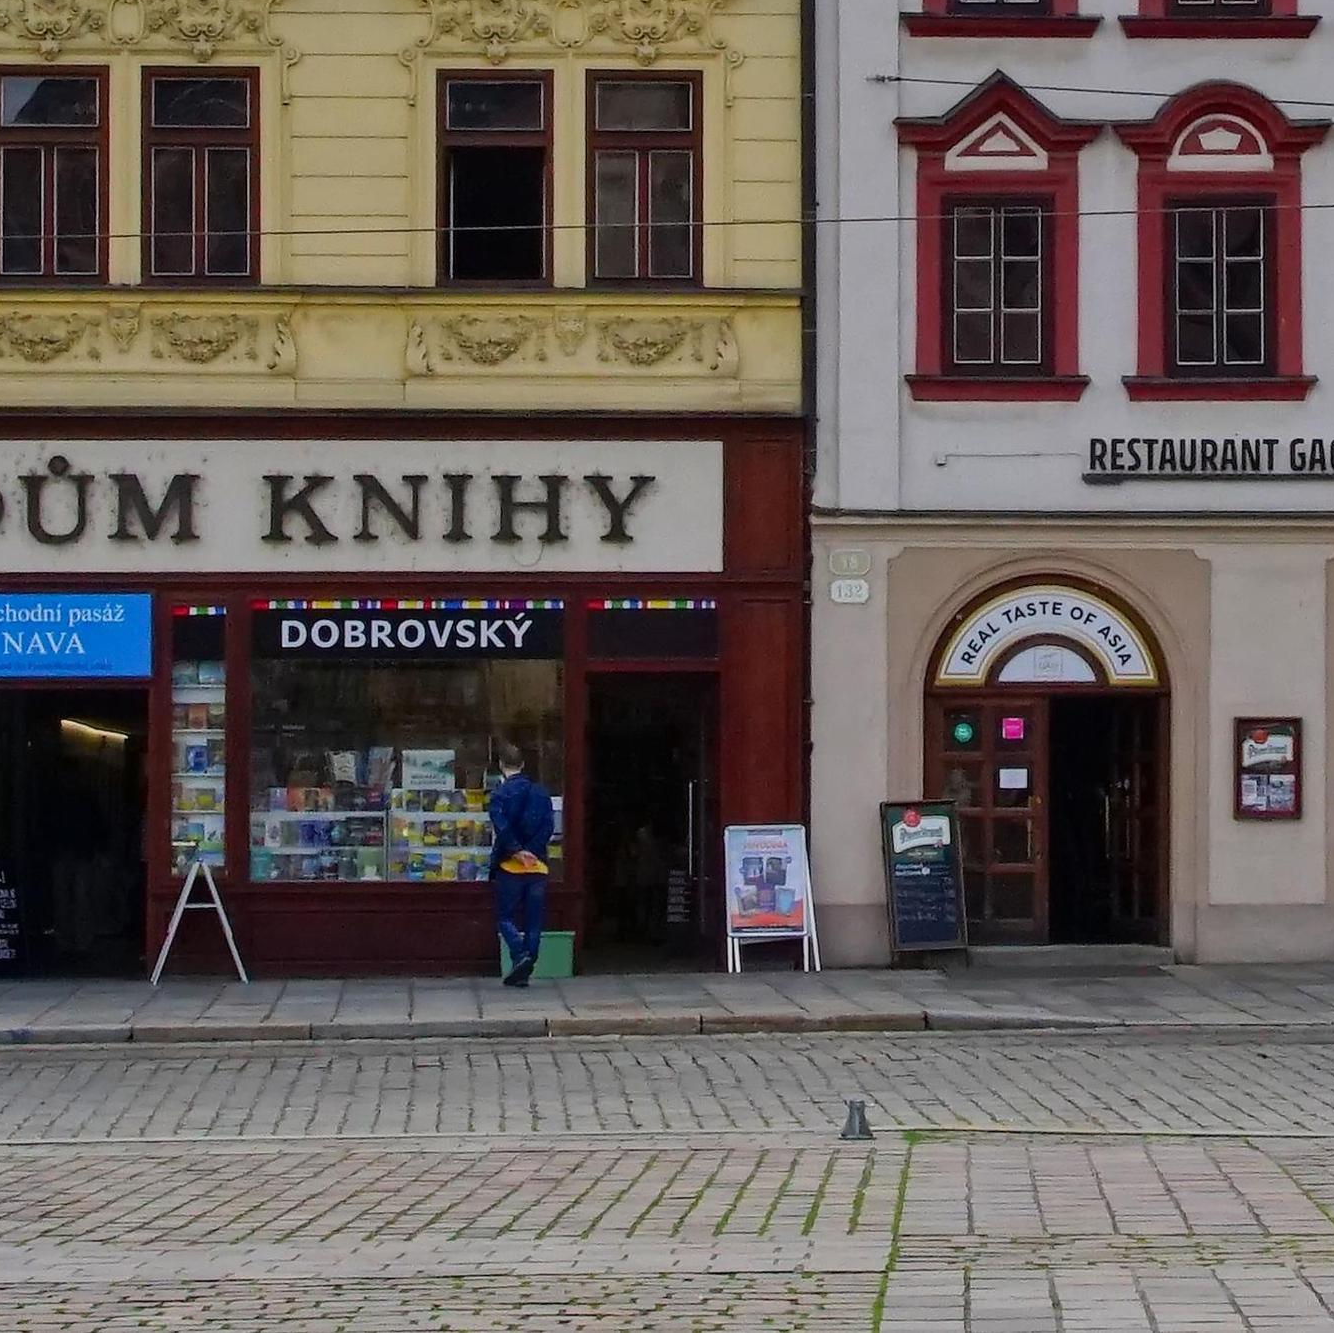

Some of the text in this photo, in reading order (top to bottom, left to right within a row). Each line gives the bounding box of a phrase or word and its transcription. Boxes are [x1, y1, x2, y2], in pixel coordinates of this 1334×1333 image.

[1089, 438, 1279, 471] RESTAURANT
[261, 474, 656, 542] KNIHY
[836, 582, 866, 599] 132
[69, 604, 125, 627] pasáž
[281, 612, 533, 649] DOBROVSKÝ
[2, 632, 86, 655] NAVA
[961, 601, 1132, 666] REAL TASTE OF ASIA
